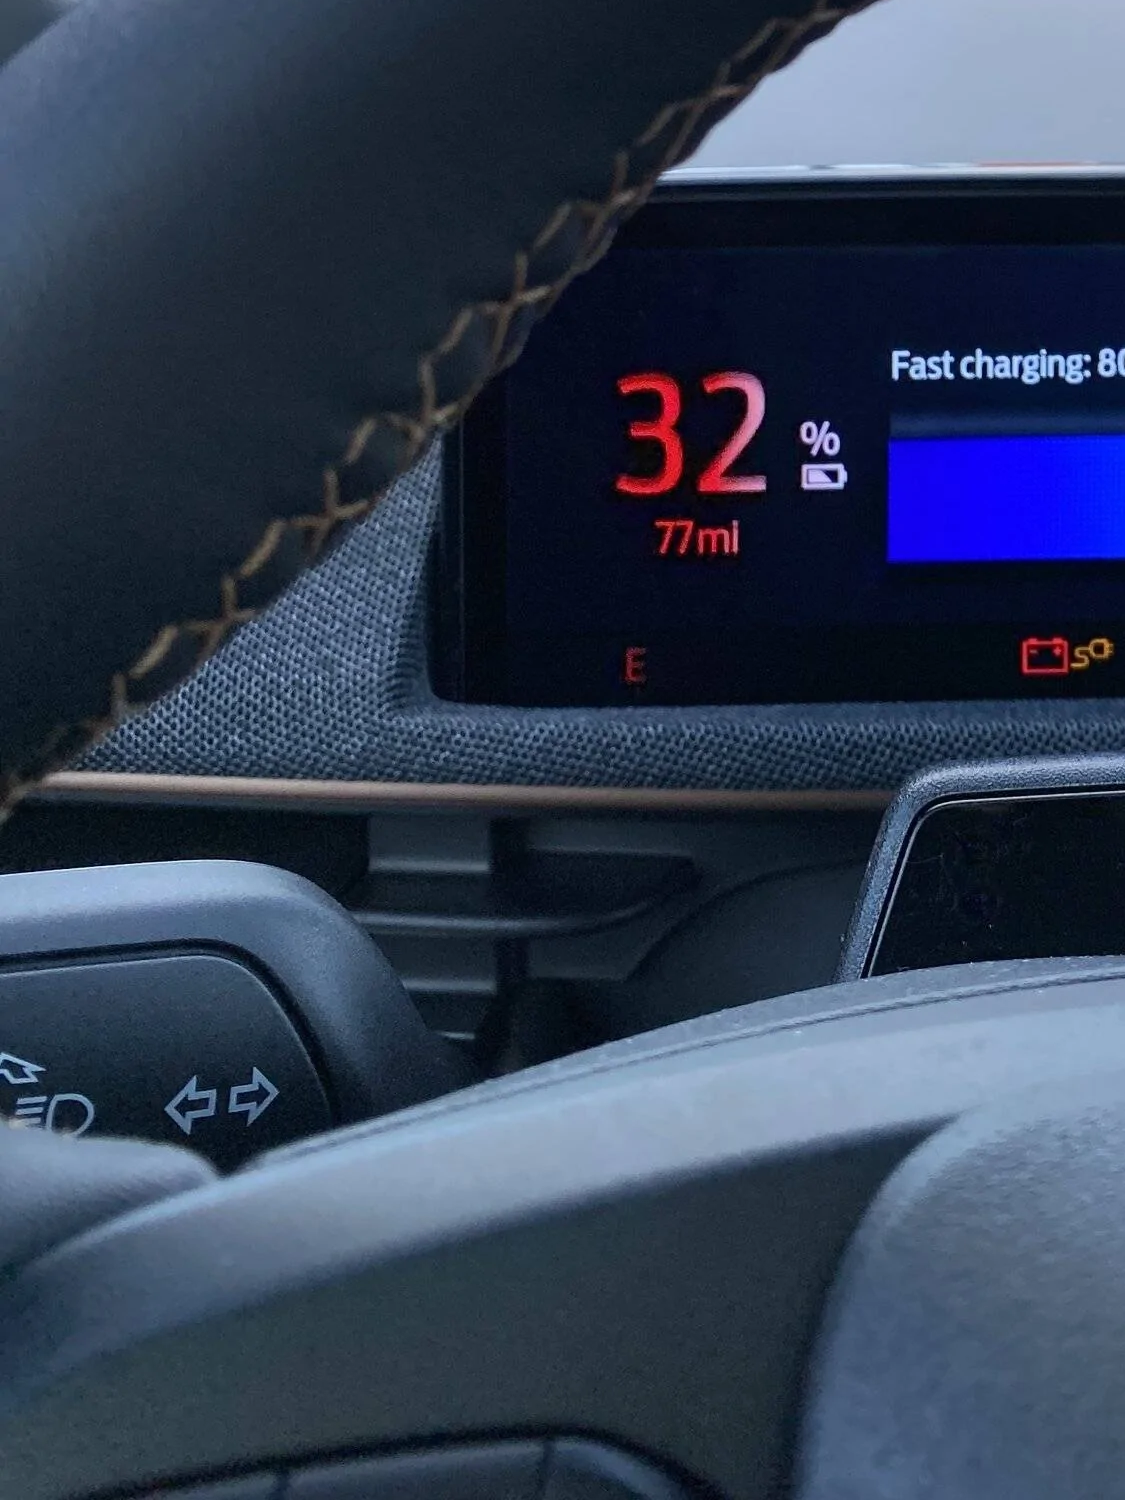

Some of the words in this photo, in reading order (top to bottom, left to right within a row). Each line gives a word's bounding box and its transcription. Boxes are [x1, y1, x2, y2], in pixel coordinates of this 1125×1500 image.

[891, 349, 955, 381] Fast
[959, 348, 1092, 385] charging:
[616, 371, 768, 495] 32
[799, 420, 842, 457] %
